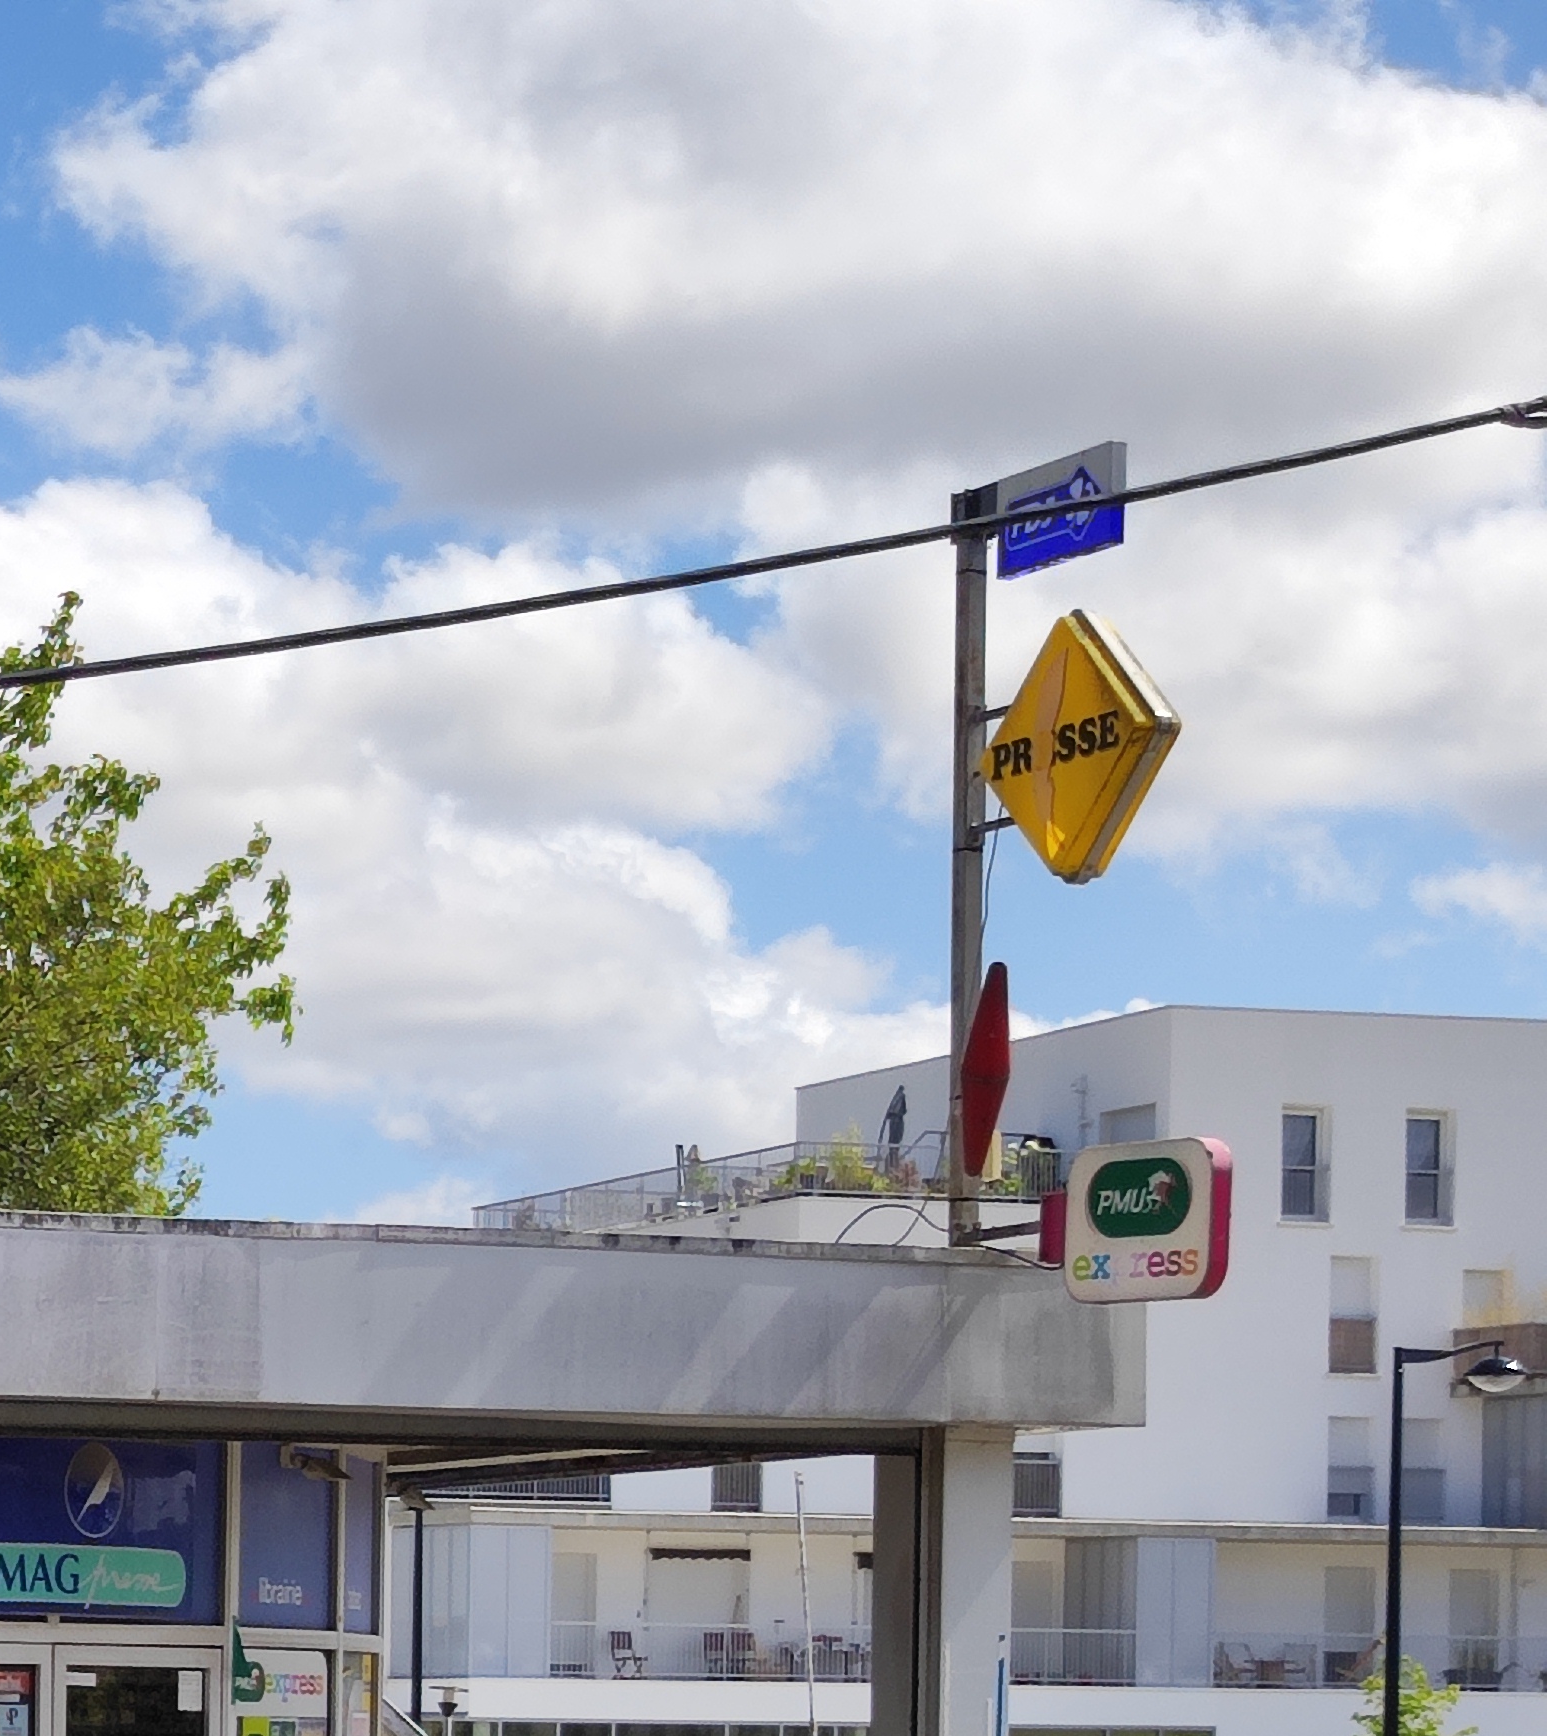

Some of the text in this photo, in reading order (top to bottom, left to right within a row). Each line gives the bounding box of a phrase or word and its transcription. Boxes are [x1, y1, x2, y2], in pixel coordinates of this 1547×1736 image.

[991, 710, 1120, 781] PRSSE
[1096, 1189, 1151, 1216] PMU
[1072, 1249, 1199, 1284] exress
[264, 1673, 324, 1703] express
